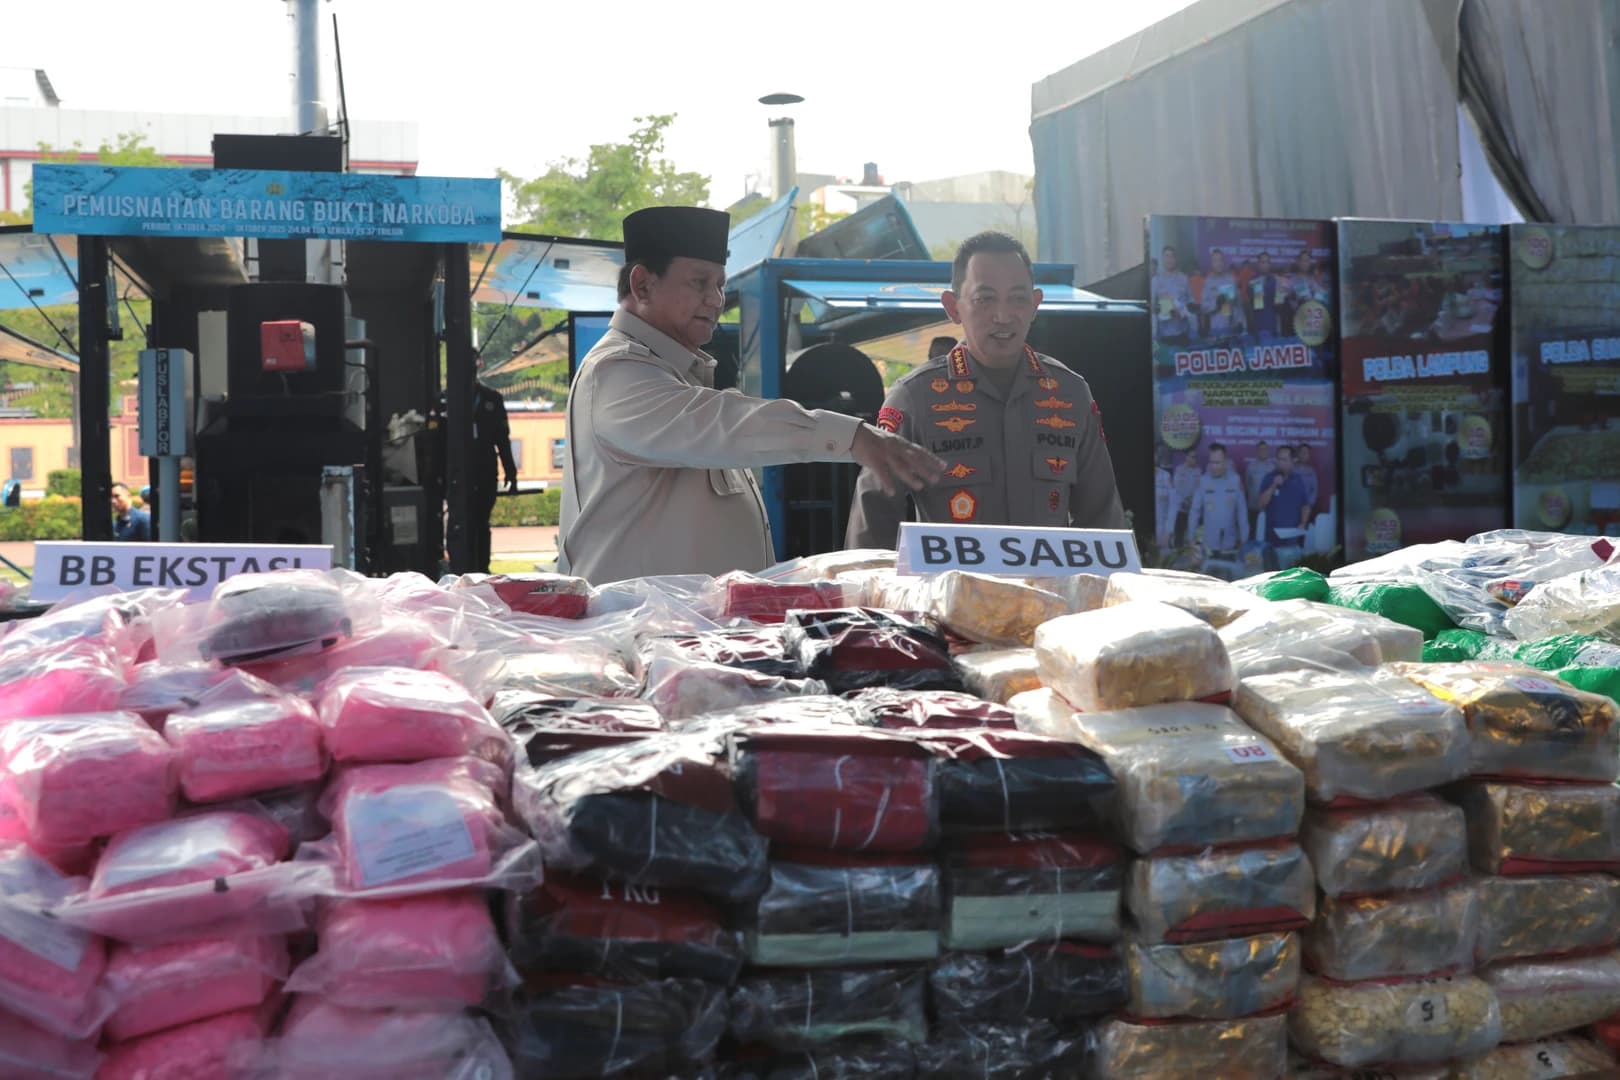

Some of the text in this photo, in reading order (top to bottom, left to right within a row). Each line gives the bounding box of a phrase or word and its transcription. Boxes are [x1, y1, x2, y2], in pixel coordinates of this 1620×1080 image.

[63, 194, 477, 226] PEMUSNAHAN BARANG BUKTI NARKOBA
[1176, 343, 1312, 376] POLDA JAMBI
[158, 351, 169, 454] PUSLABFOR
[1037, 433, 1076, 449] POLRI
[920, 535, 1128, 569] BB SABU
[59, 555, 116, 587] BB
